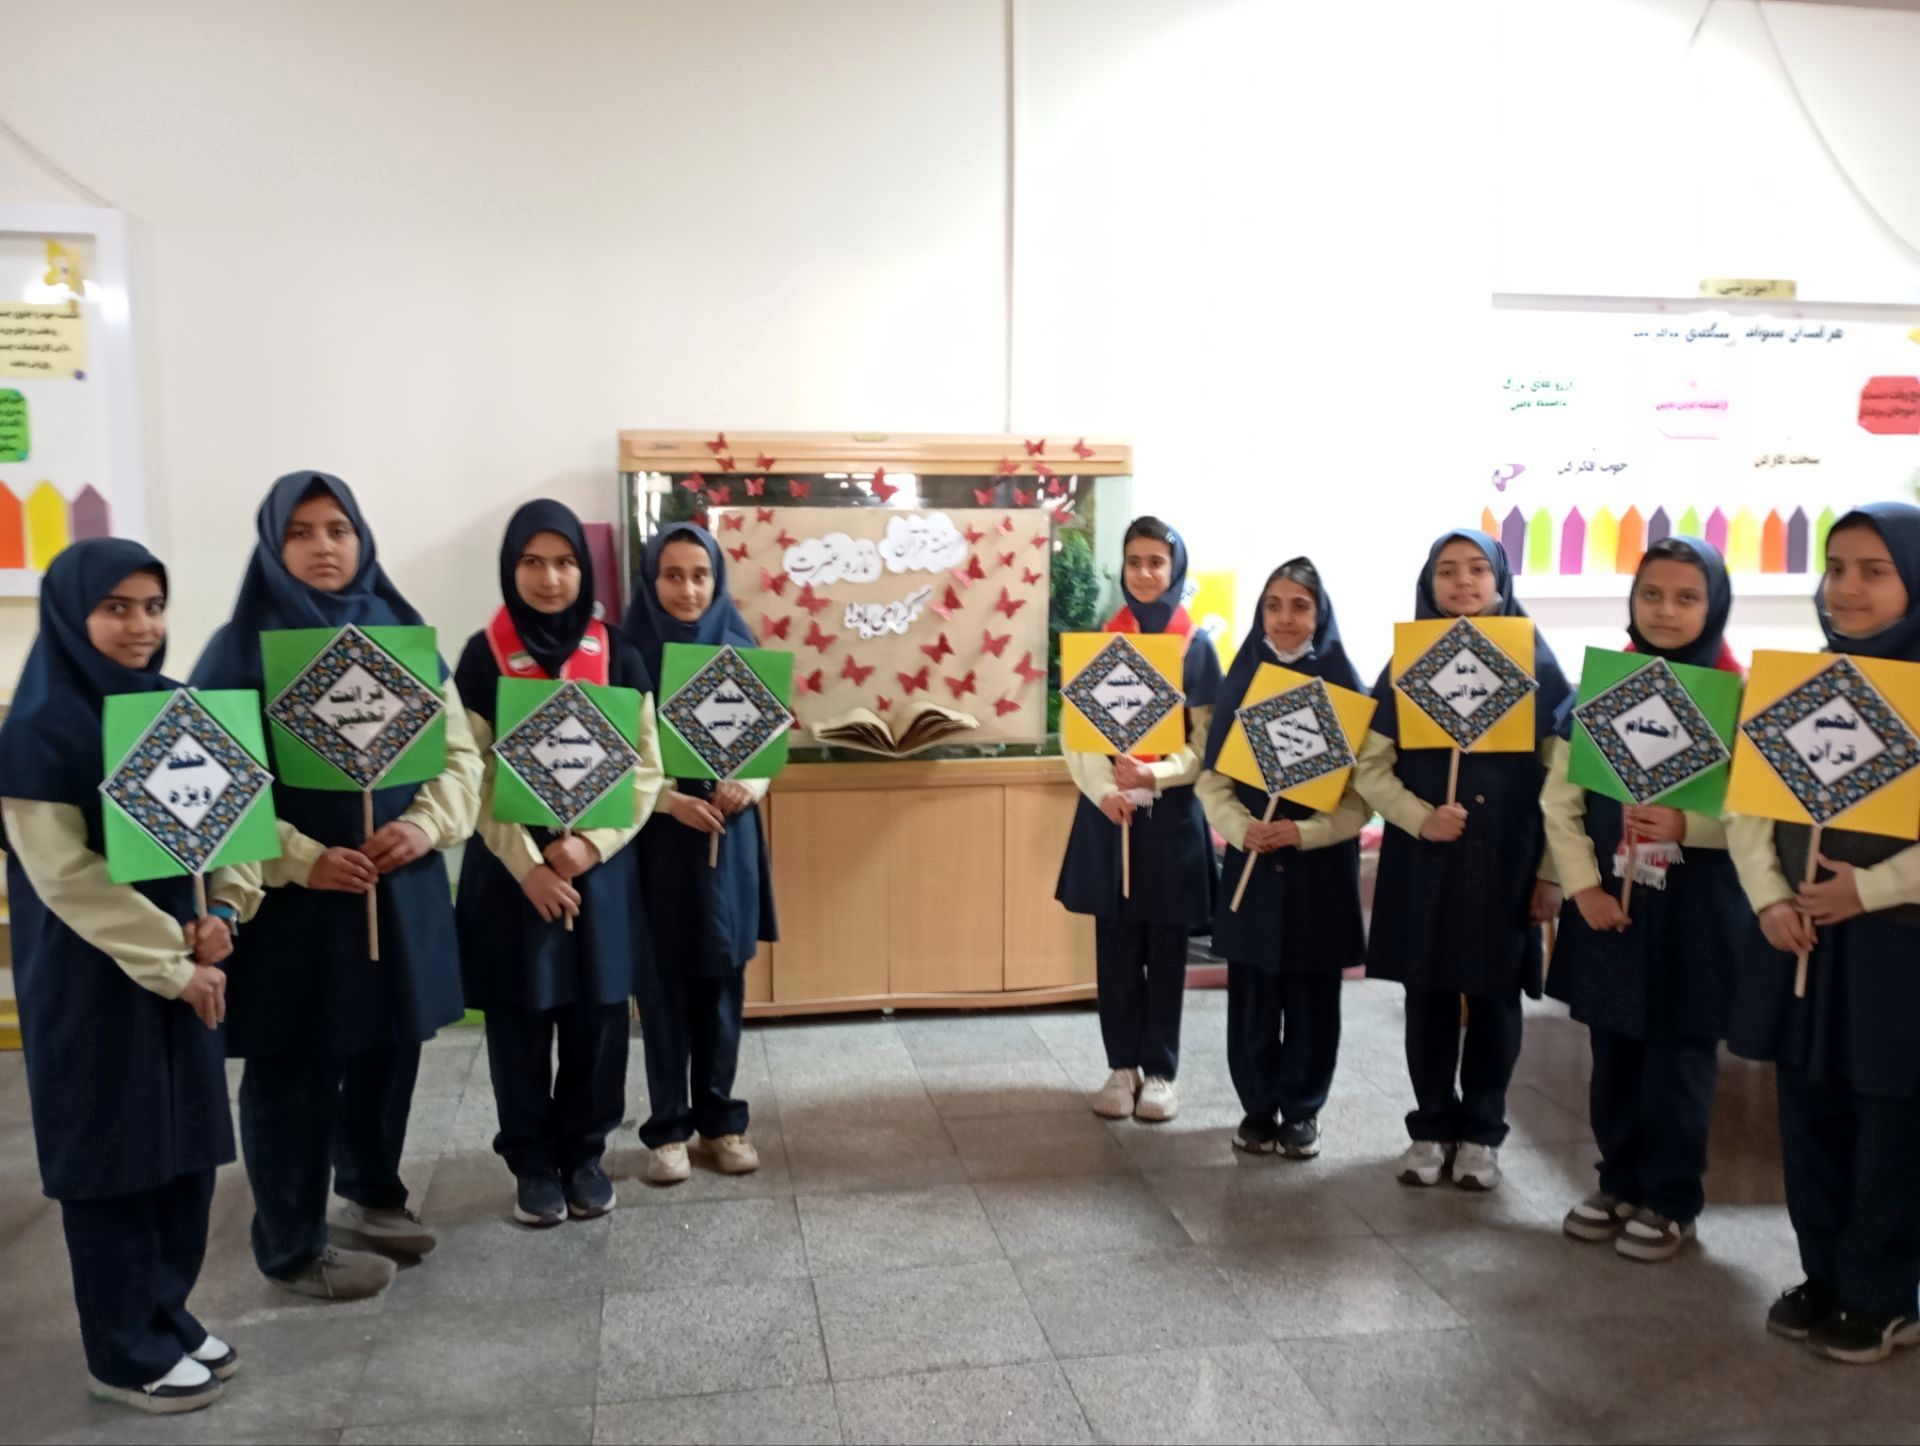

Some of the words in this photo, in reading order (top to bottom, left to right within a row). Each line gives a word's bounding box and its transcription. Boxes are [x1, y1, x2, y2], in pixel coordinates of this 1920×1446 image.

[1455, 662, 1478, 675] دعا
[329, 684, 385, 705] قرائت
[713, 690, 745, 704] حفظ
[1105, 695, 1142, 709] خوانی
[1446, 684, 1489, 701] خوانی
[1625, 716, 1680, 740] احکام
[1814, 712, 1858, 732] فهم
[167, 750, 207, 771] حفظ
[1808, 740, 1857, 765] قرآن
[169, 784, 213, 808] ویژه
